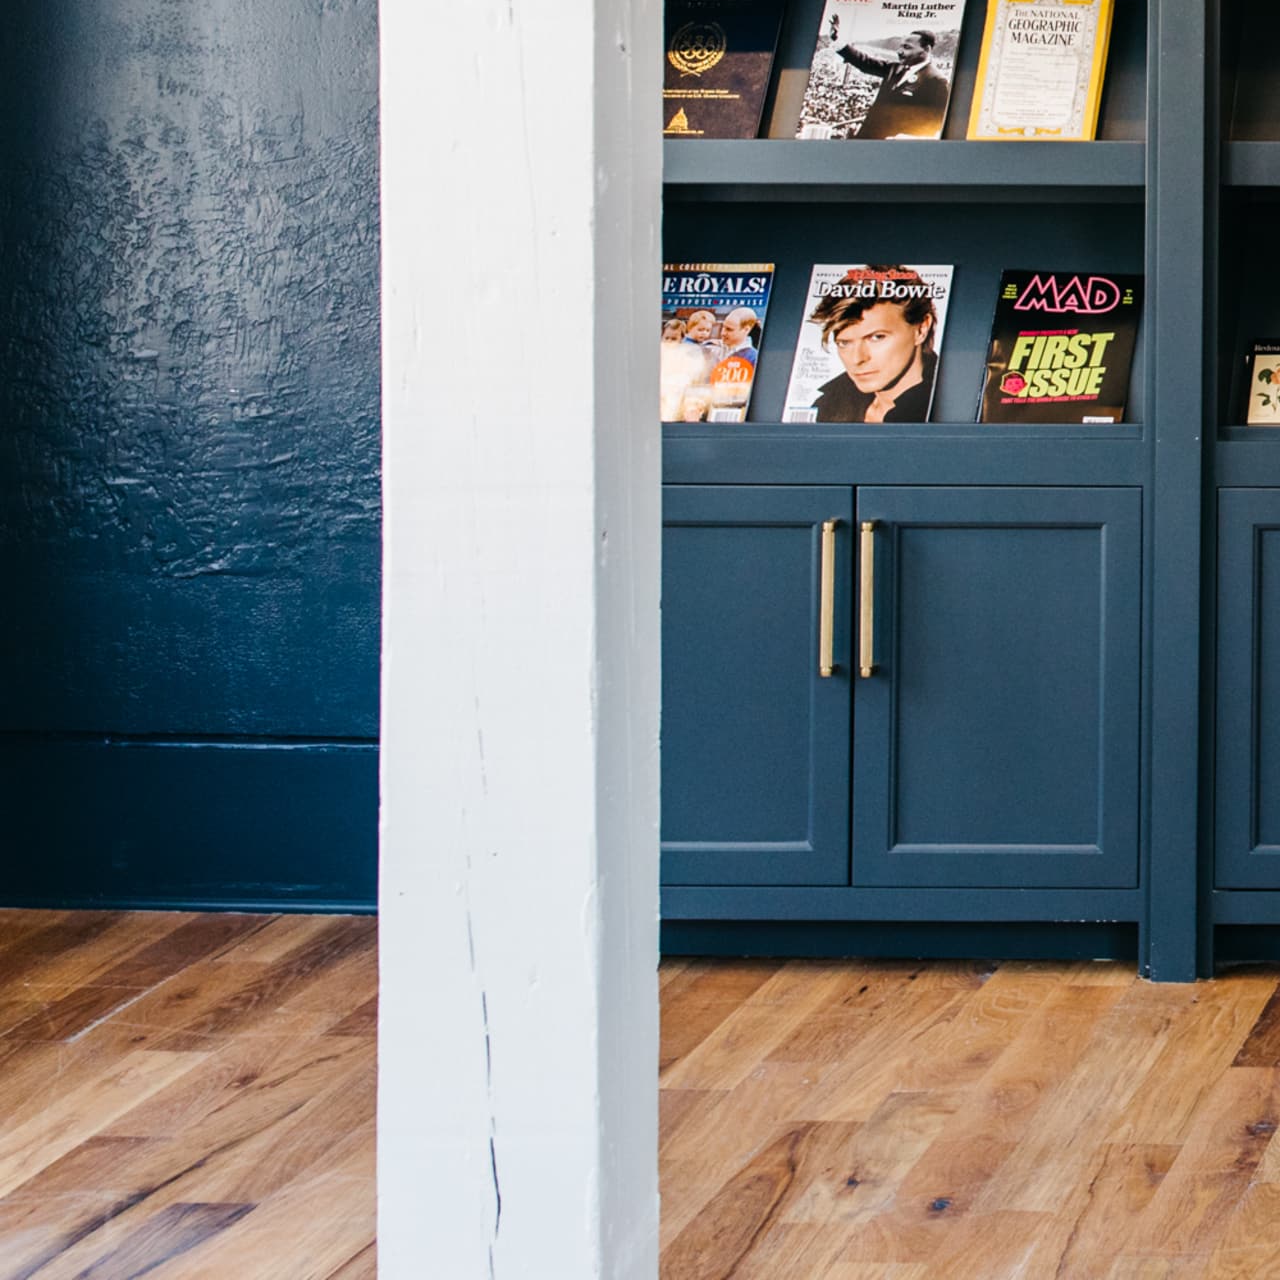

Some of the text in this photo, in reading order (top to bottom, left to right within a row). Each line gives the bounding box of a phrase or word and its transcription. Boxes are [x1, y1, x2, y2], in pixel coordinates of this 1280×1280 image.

[881, 2, 956, 11] Martin Luther
[897, 10, 922, 19] King
[1031, 10, 1081, 20] NATIONAL
[1008, 19, 1081, 33] GEOGRAPHIC
[1011, 32, 1075, 46] MAGAZINE
[679, 275, 767, 293] ROYALS!
[813, 280, 946, 299] David Bowie
[1014, 274, 1120, 313] MAD
[1008, 332, 1115, 370] FIRST
[716, 366, 749, 382] 300
[1018, 367, 1107, 398] ISSUE
